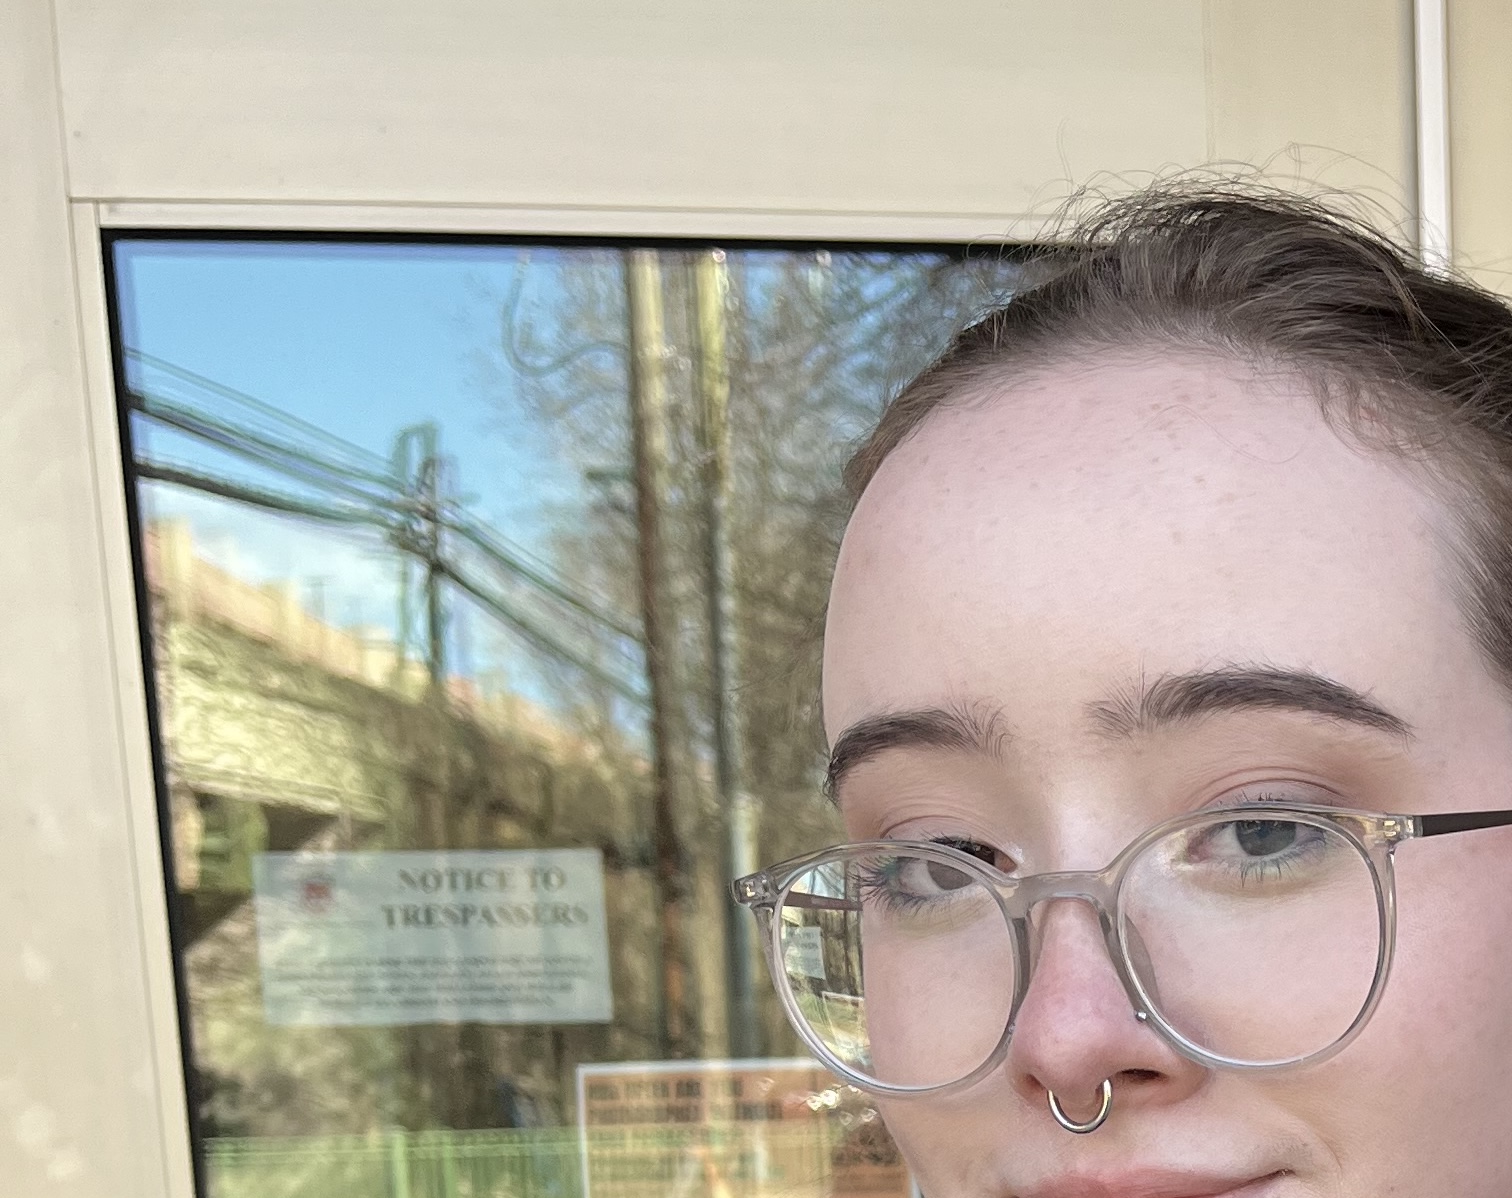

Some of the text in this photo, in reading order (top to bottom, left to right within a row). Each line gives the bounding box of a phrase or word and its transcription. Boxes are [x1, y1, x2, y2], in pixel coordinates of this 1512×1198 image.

[400, 866, 568, 893] NOTICE TO
[380, 902, 589, 930] TRESPASSERS
